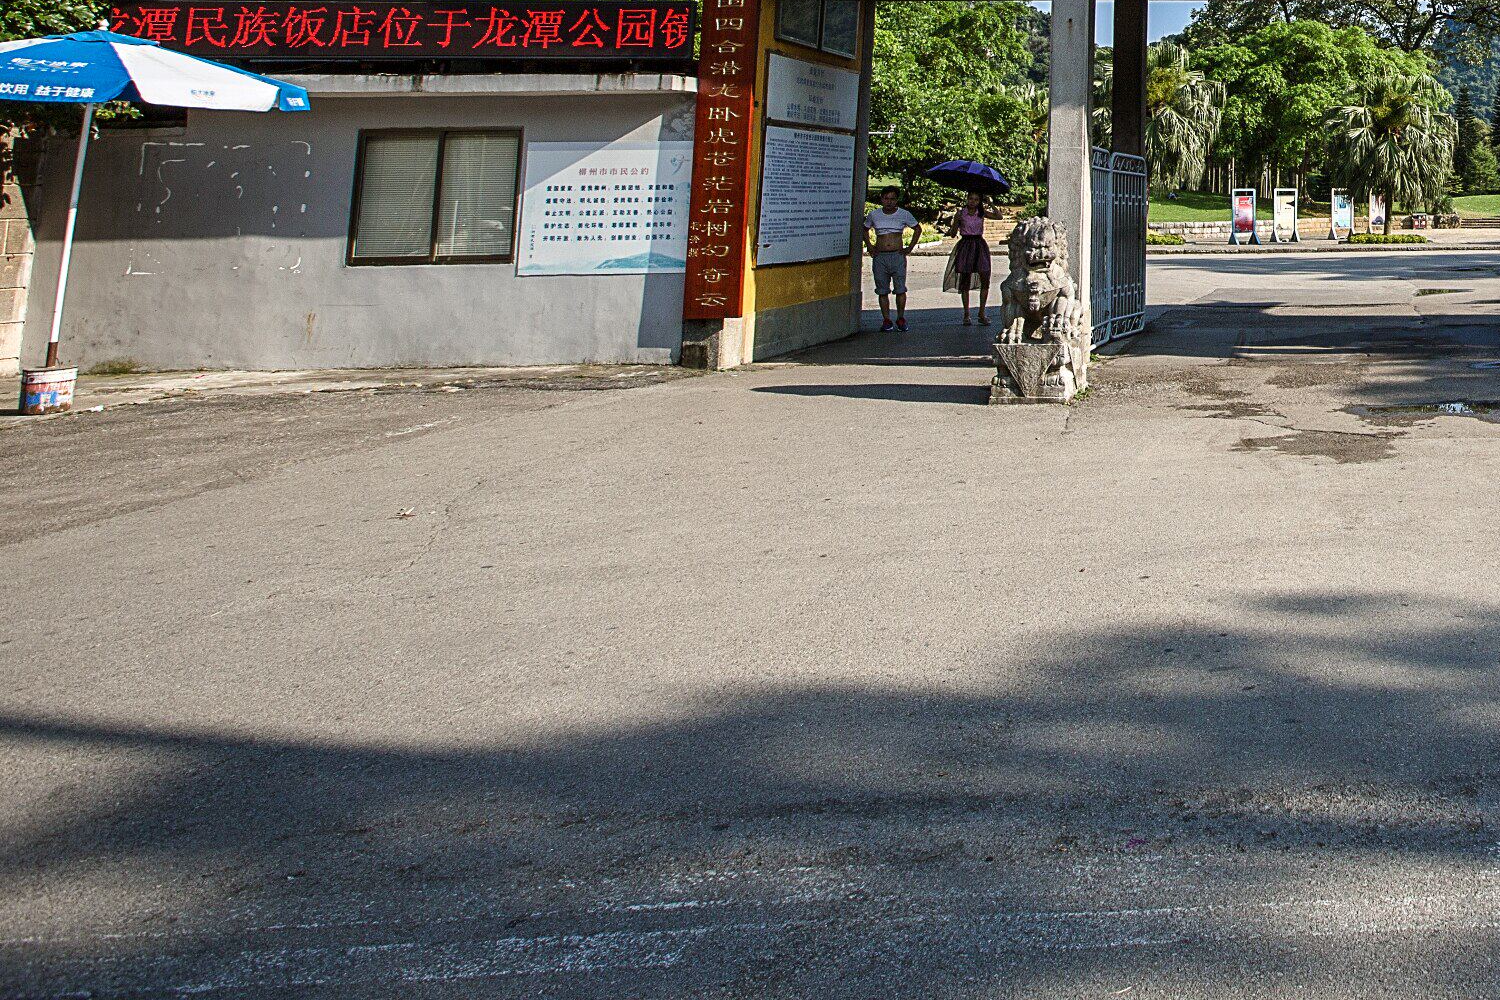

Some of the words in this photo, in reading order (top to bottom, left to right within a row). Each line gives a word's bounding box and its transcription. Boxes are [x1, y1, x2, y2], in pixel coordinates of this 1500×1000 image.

[34, 85, 96, 98] 益于健康
[578, 167, 650, 176] 柳州市市民公约
